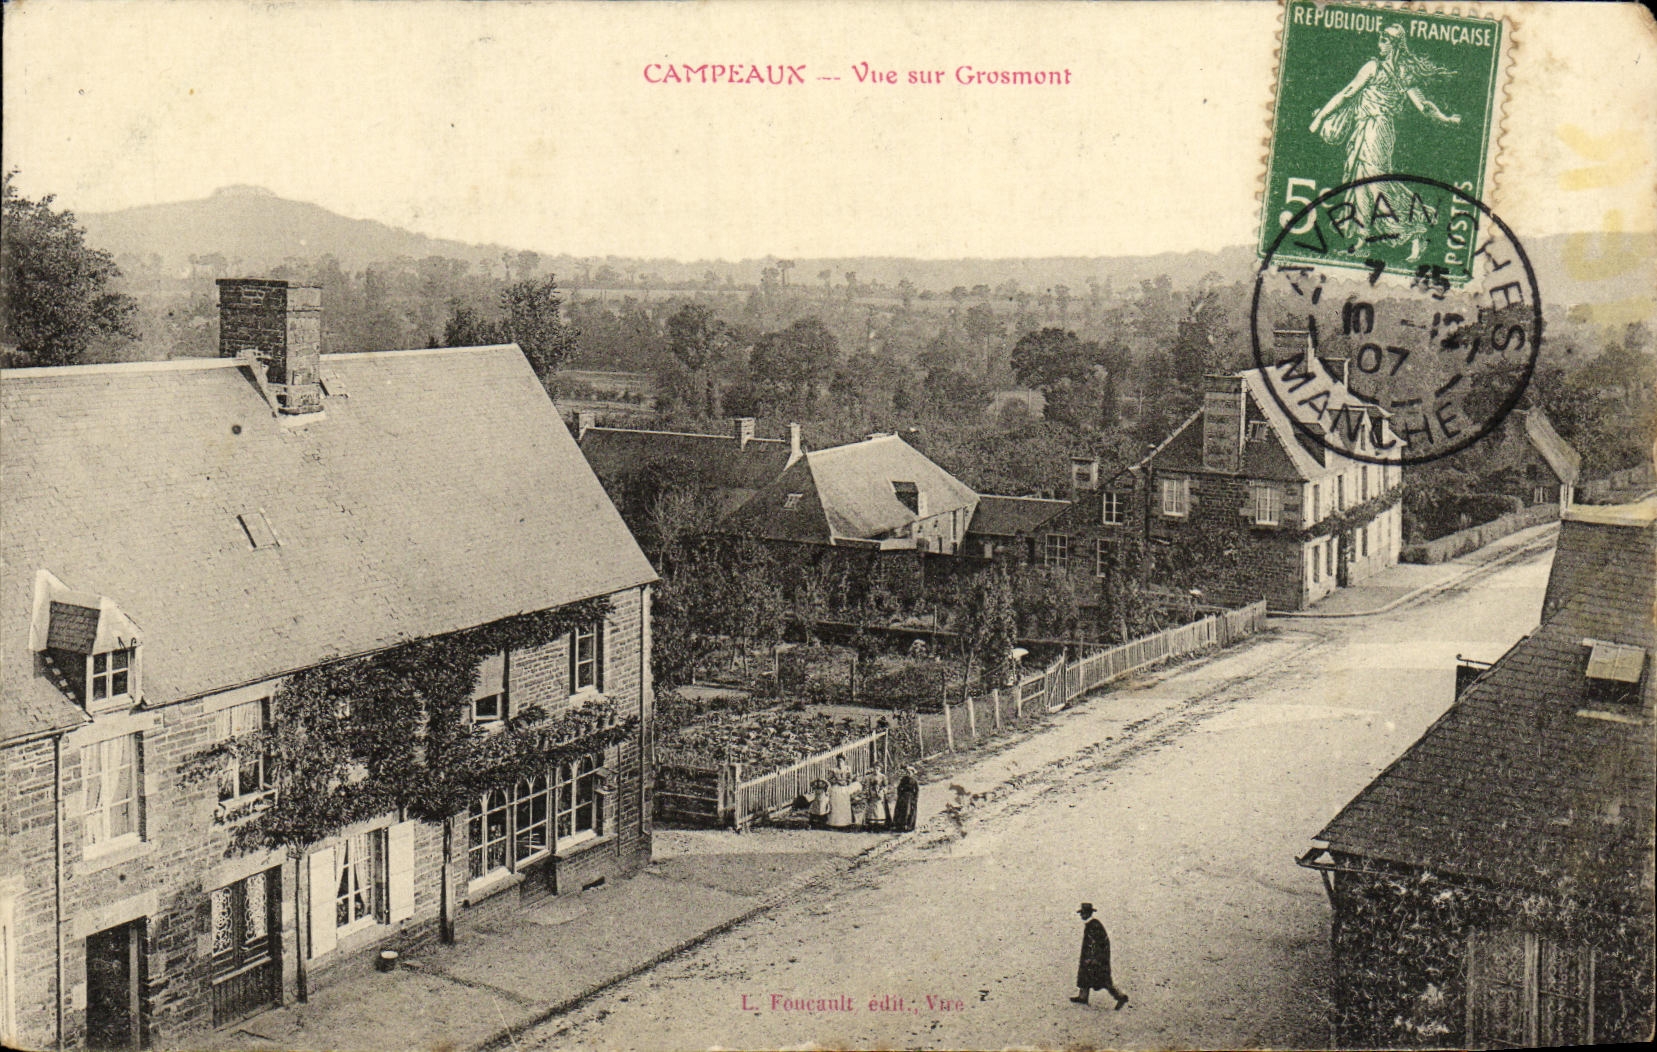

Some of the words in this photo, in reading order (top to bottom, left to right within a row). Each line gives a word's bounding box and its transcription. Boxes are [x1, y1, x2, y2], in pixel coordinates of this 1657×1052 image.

[1293, 6, 1383, 33] REPUBLIQUE
[1410, 20, 1491, 47] FRANÇAISE
[1444, 181, 1473, 265] POSTES
[1357, 342, 1410, 376] 07
[1276, 351, 1463, 450] MANCHE
